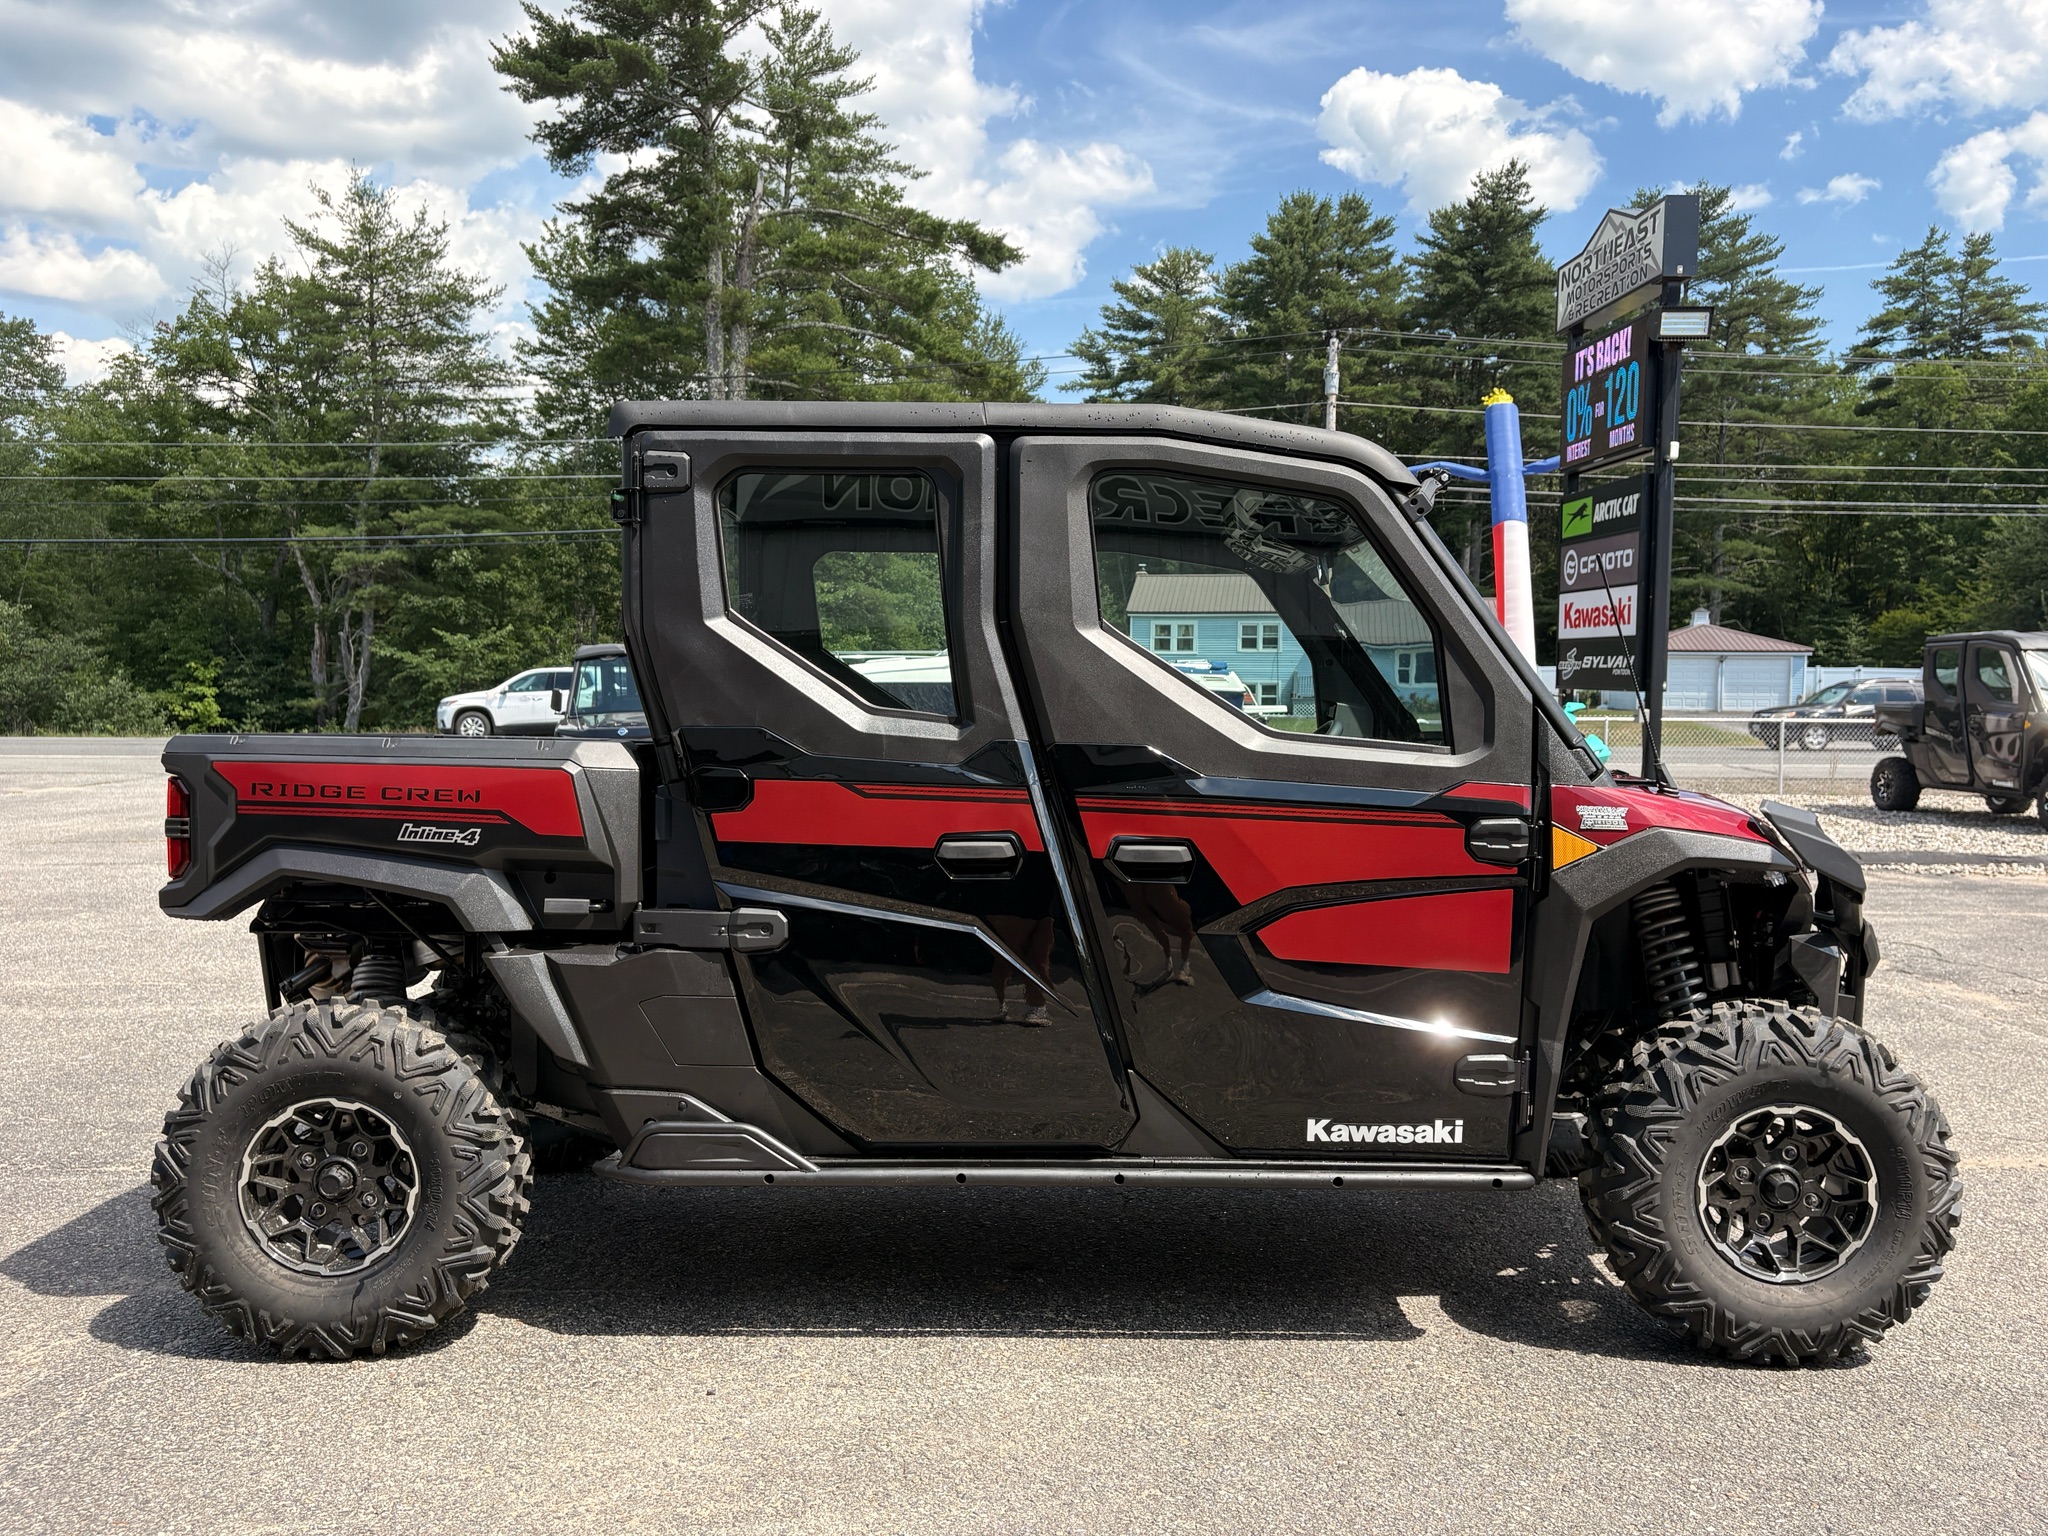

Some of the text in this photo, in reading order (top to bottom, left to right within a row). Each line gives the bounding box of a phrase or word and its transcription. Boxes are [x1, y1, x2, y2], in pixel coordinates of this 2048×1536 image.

[1561, 208, 1661, 292] NORTHEAST
[1566, 240, 1652, 306] MOTORSPORTS
[1575, 264, 1648, 318] RECREATION
[1574, 325, 1633, 383] IT'S BACK!
[1566, 360, 1640, 443] 0% FOR 120
[1566, 422, 1636, 463] INTEREST MONTHS
[1593, 492, 1642, 524] ARCTIC CAT
[1580, 548, 1633, 575] CFMOTO
[1563, 596, 1632, 629] Kawasaki
[1581, 655, 1635, 669] SYLVAN
[251, 782, 482, 804] RIDGE CREW
[1306, 1118, 1464, 1144] Kawasaki
